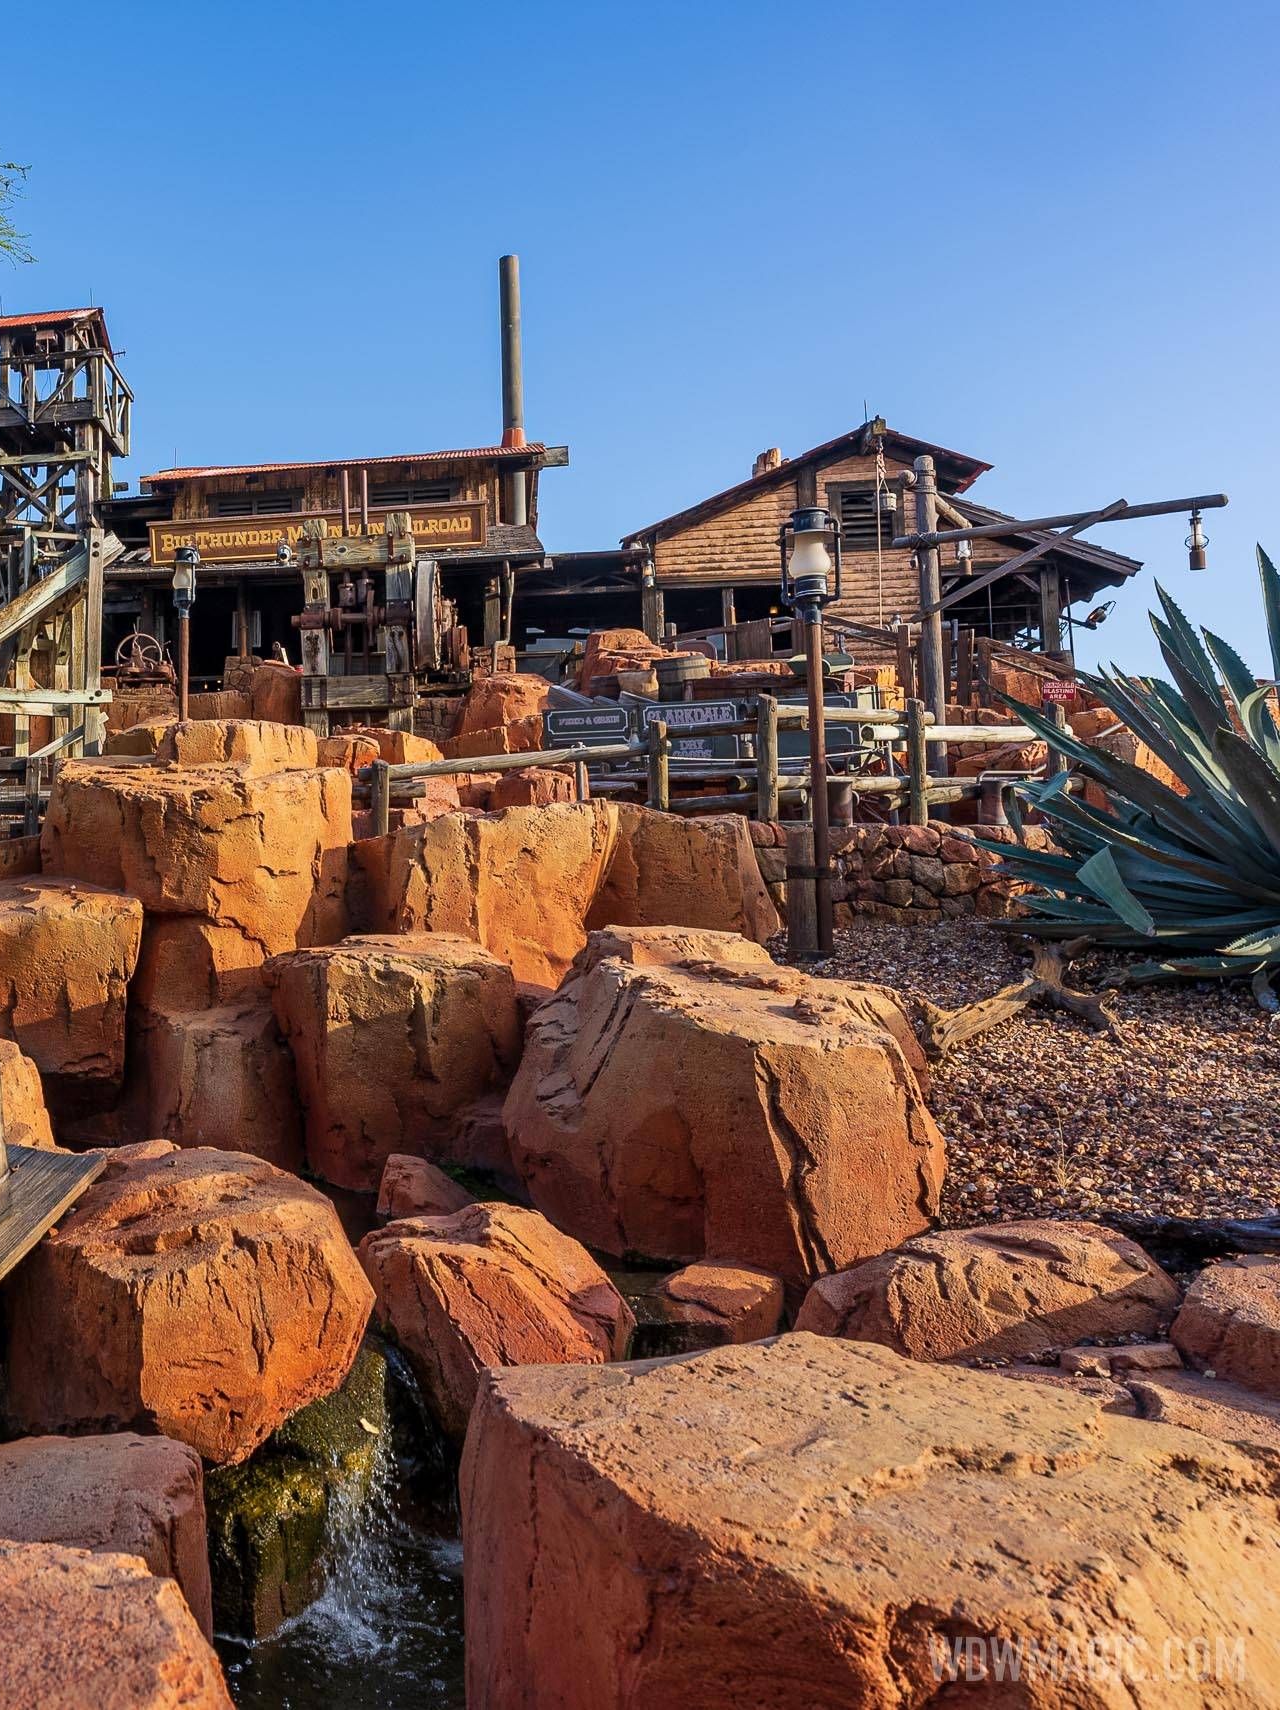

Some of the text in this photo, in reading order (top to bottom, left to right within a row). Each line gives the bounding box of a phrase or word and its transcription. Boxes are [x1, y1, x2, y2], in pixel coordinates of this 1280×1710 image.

[161, 516, 472, 552] BIG THUNDER MNTIN ILROAD
[646, 706, 732, 725] CLARKDALE
